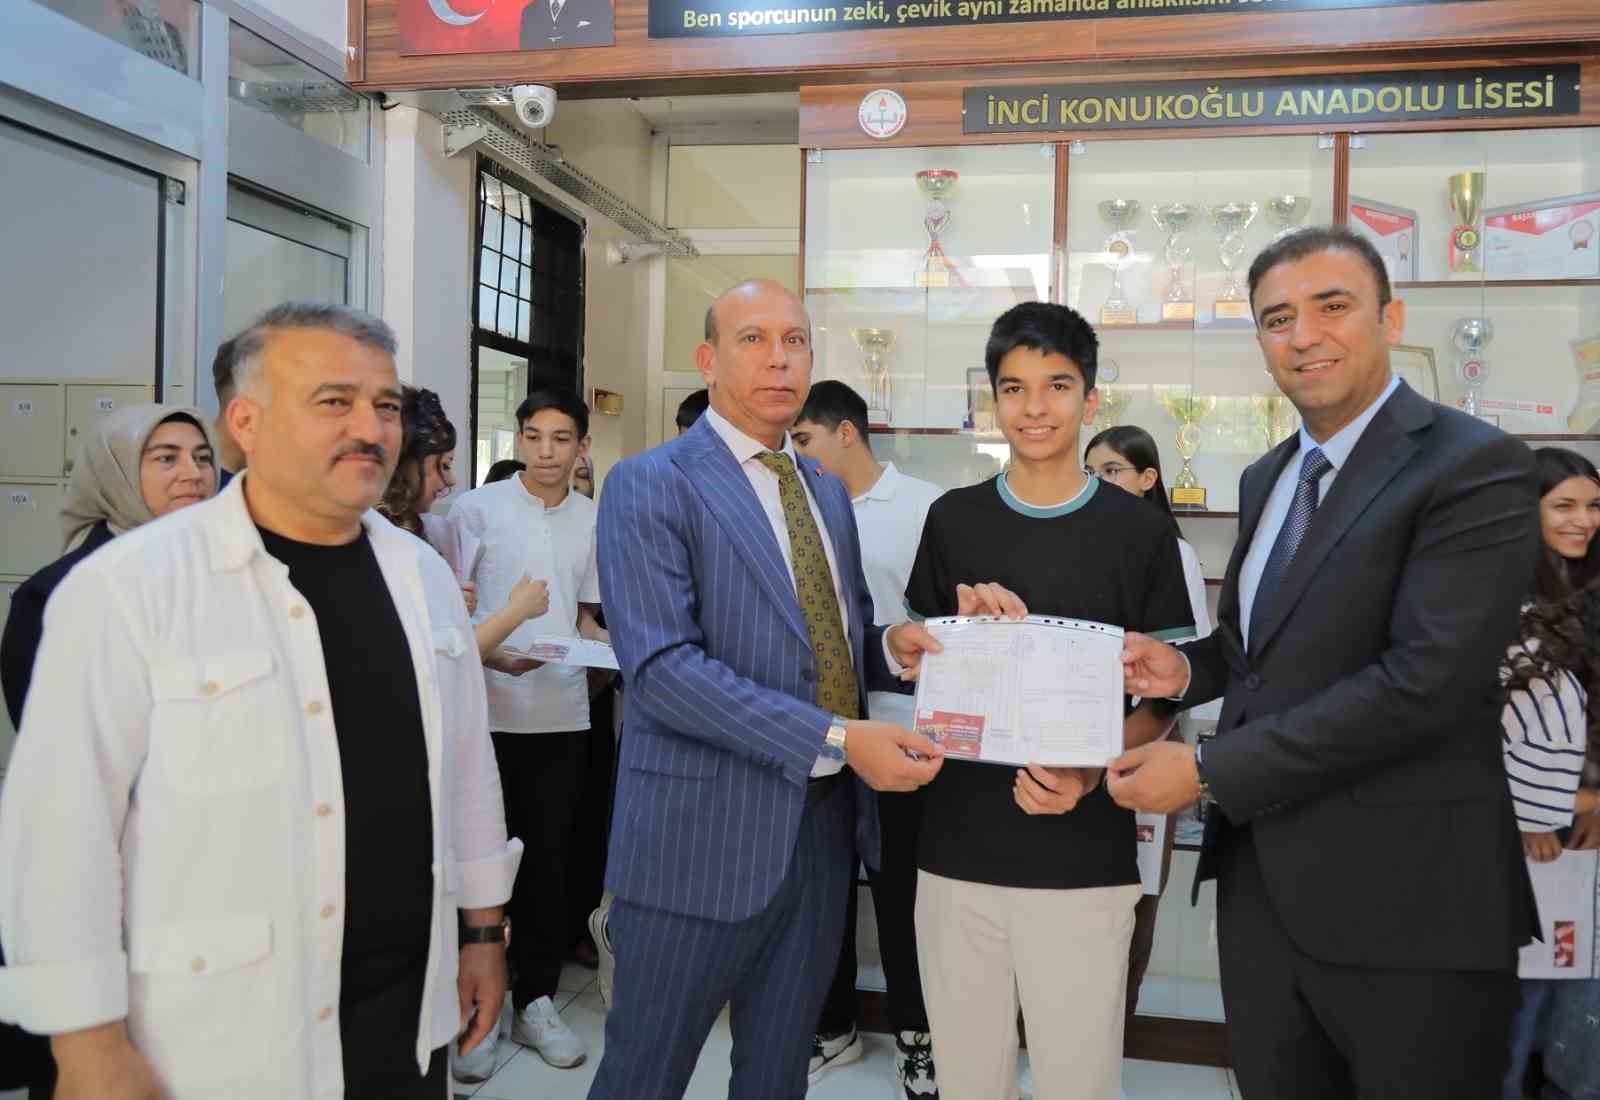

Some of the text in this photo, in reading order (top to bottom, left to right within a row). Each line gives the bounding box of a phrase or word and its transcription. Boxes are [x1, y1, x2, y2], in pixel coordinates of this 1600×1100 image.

[683, 10, 721, 28] Ben
[727, 7, 837, 30] sporcunun
[842, 1, 890, 22] zeki,
[896, 0, 952, 23] çevik
[1008, 0, 1109, 14] zamanda
[987, 75, 1554, 125] İNCİ KONUKOĞLU ANADOLU LİSESİ
